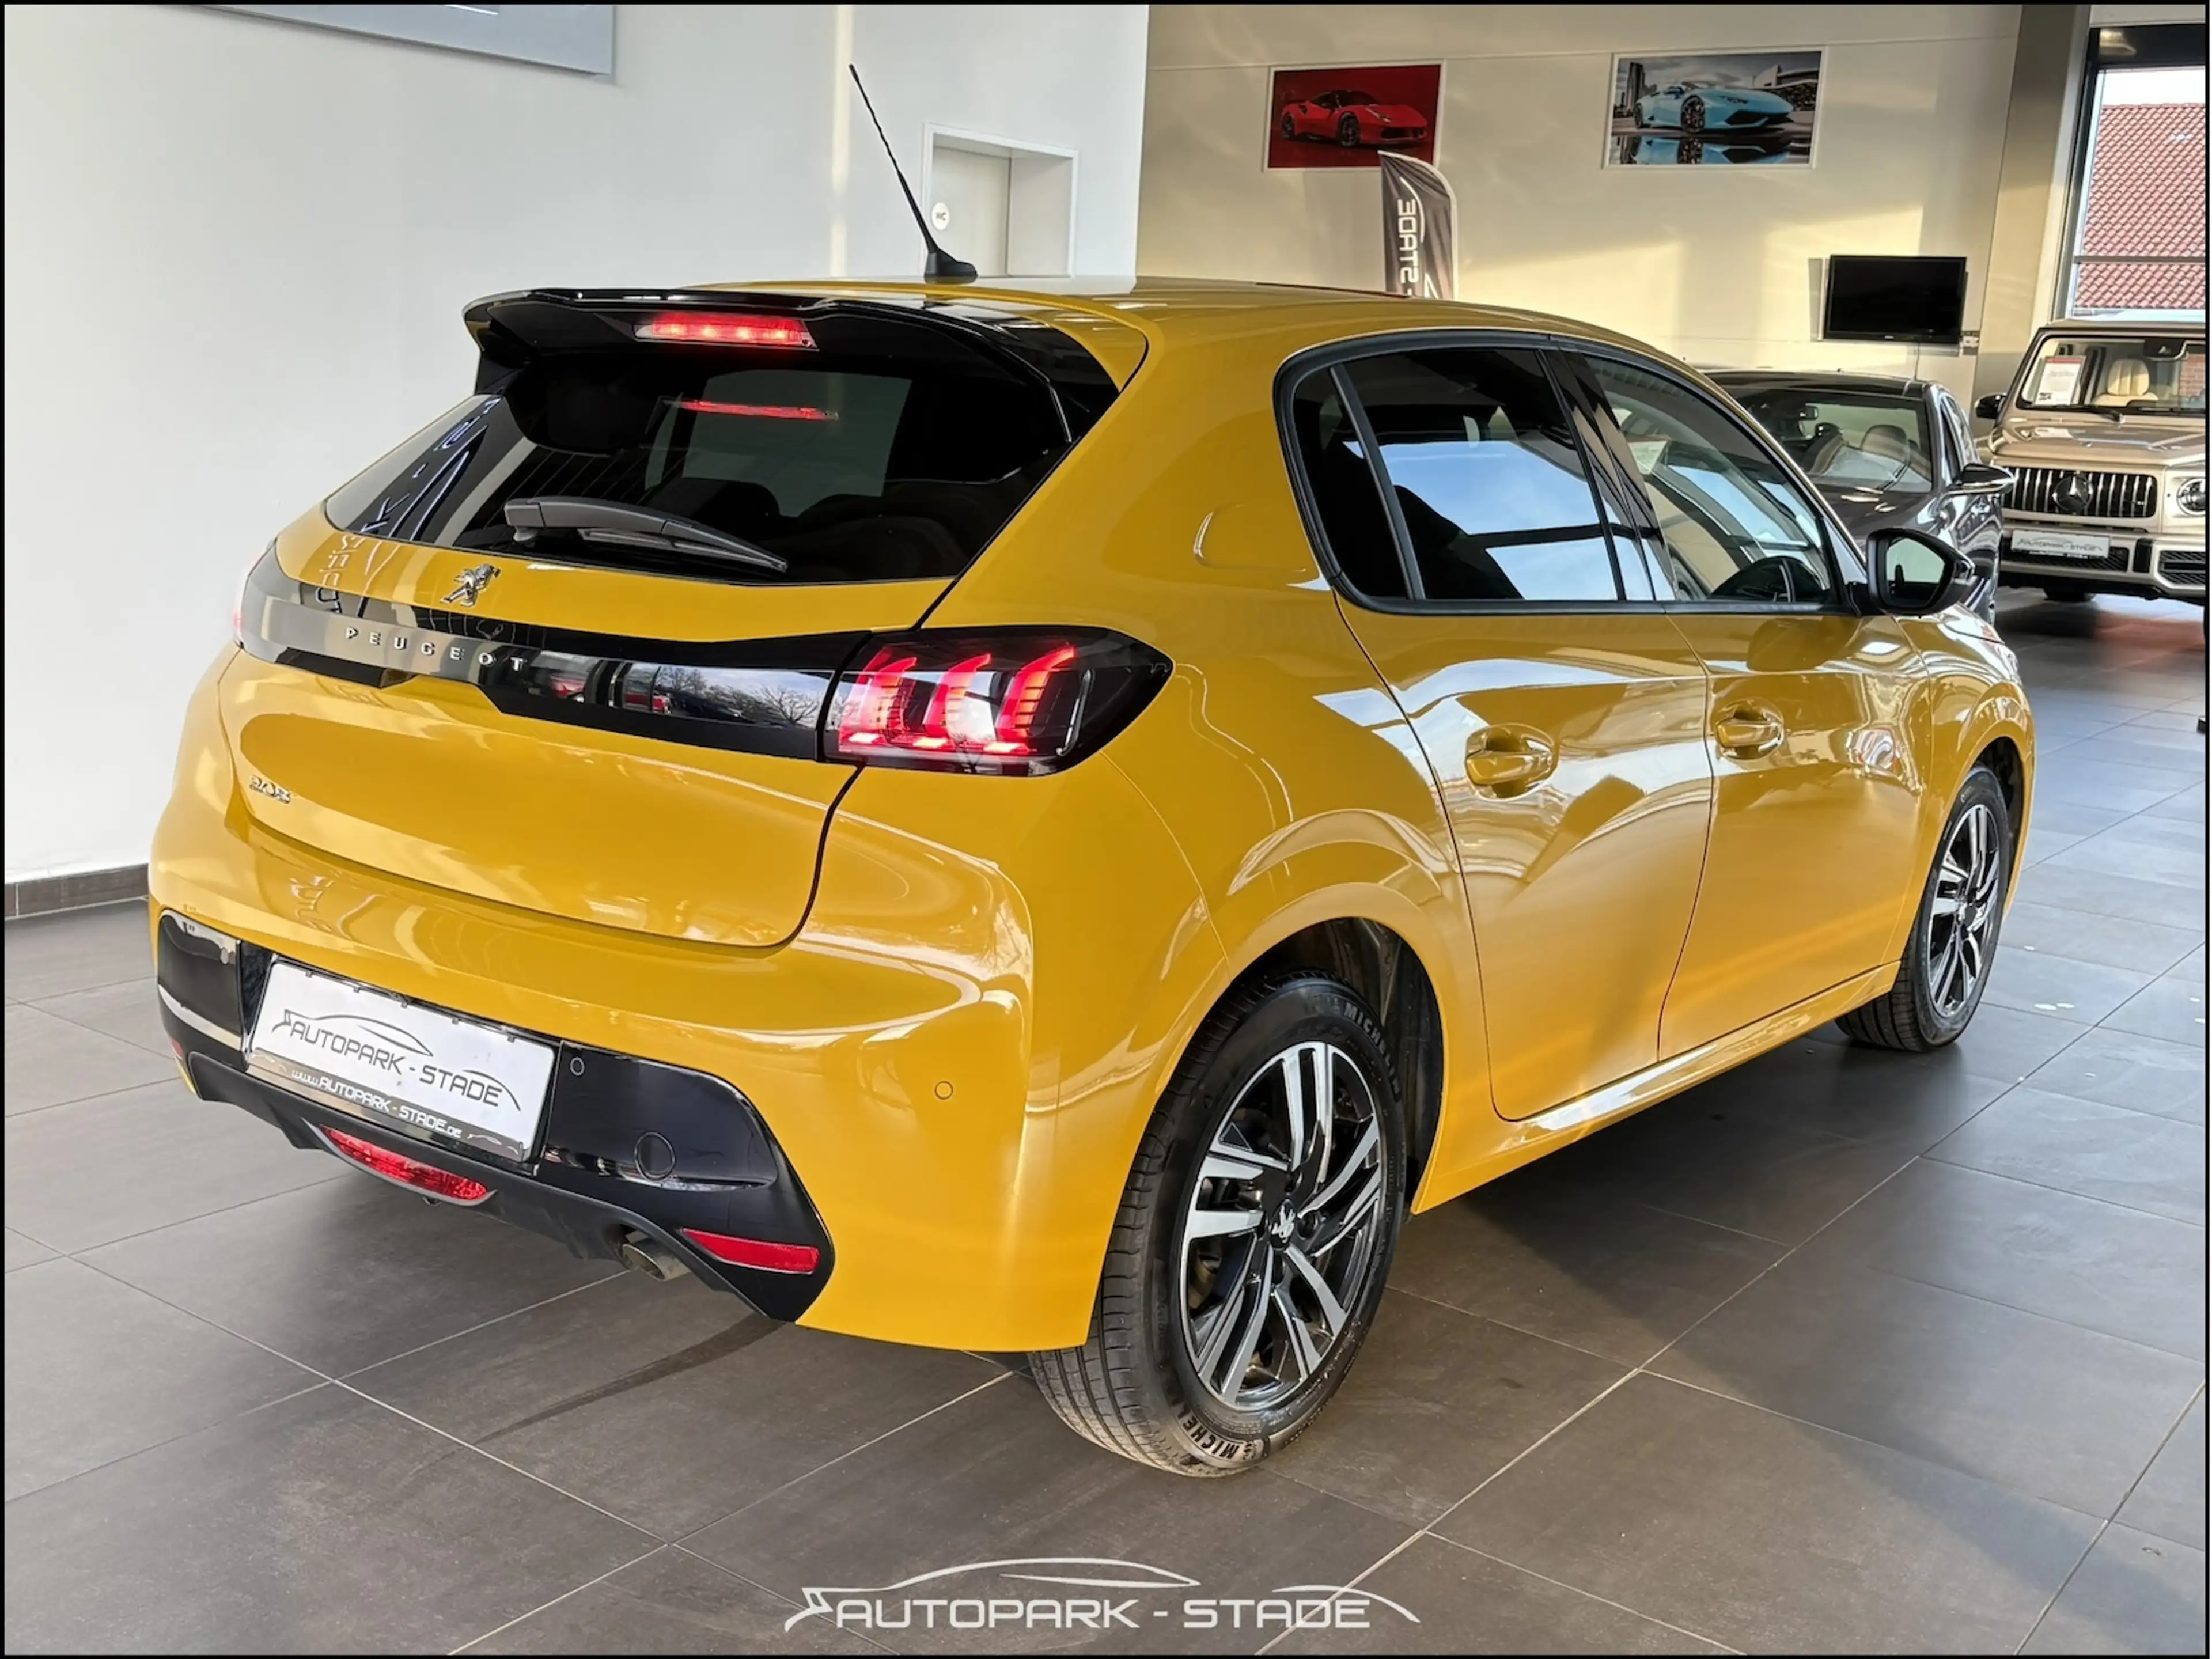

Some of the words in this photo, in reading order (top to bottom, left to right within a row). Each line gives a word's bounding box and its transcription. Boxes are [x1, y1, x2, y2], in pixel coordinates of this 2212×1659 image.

[346, 627, 525, 672] PEUGEOT
[290, 1021, 405, 1075] AUTOPARK
[419, 1064, 503, 1107] STADE
